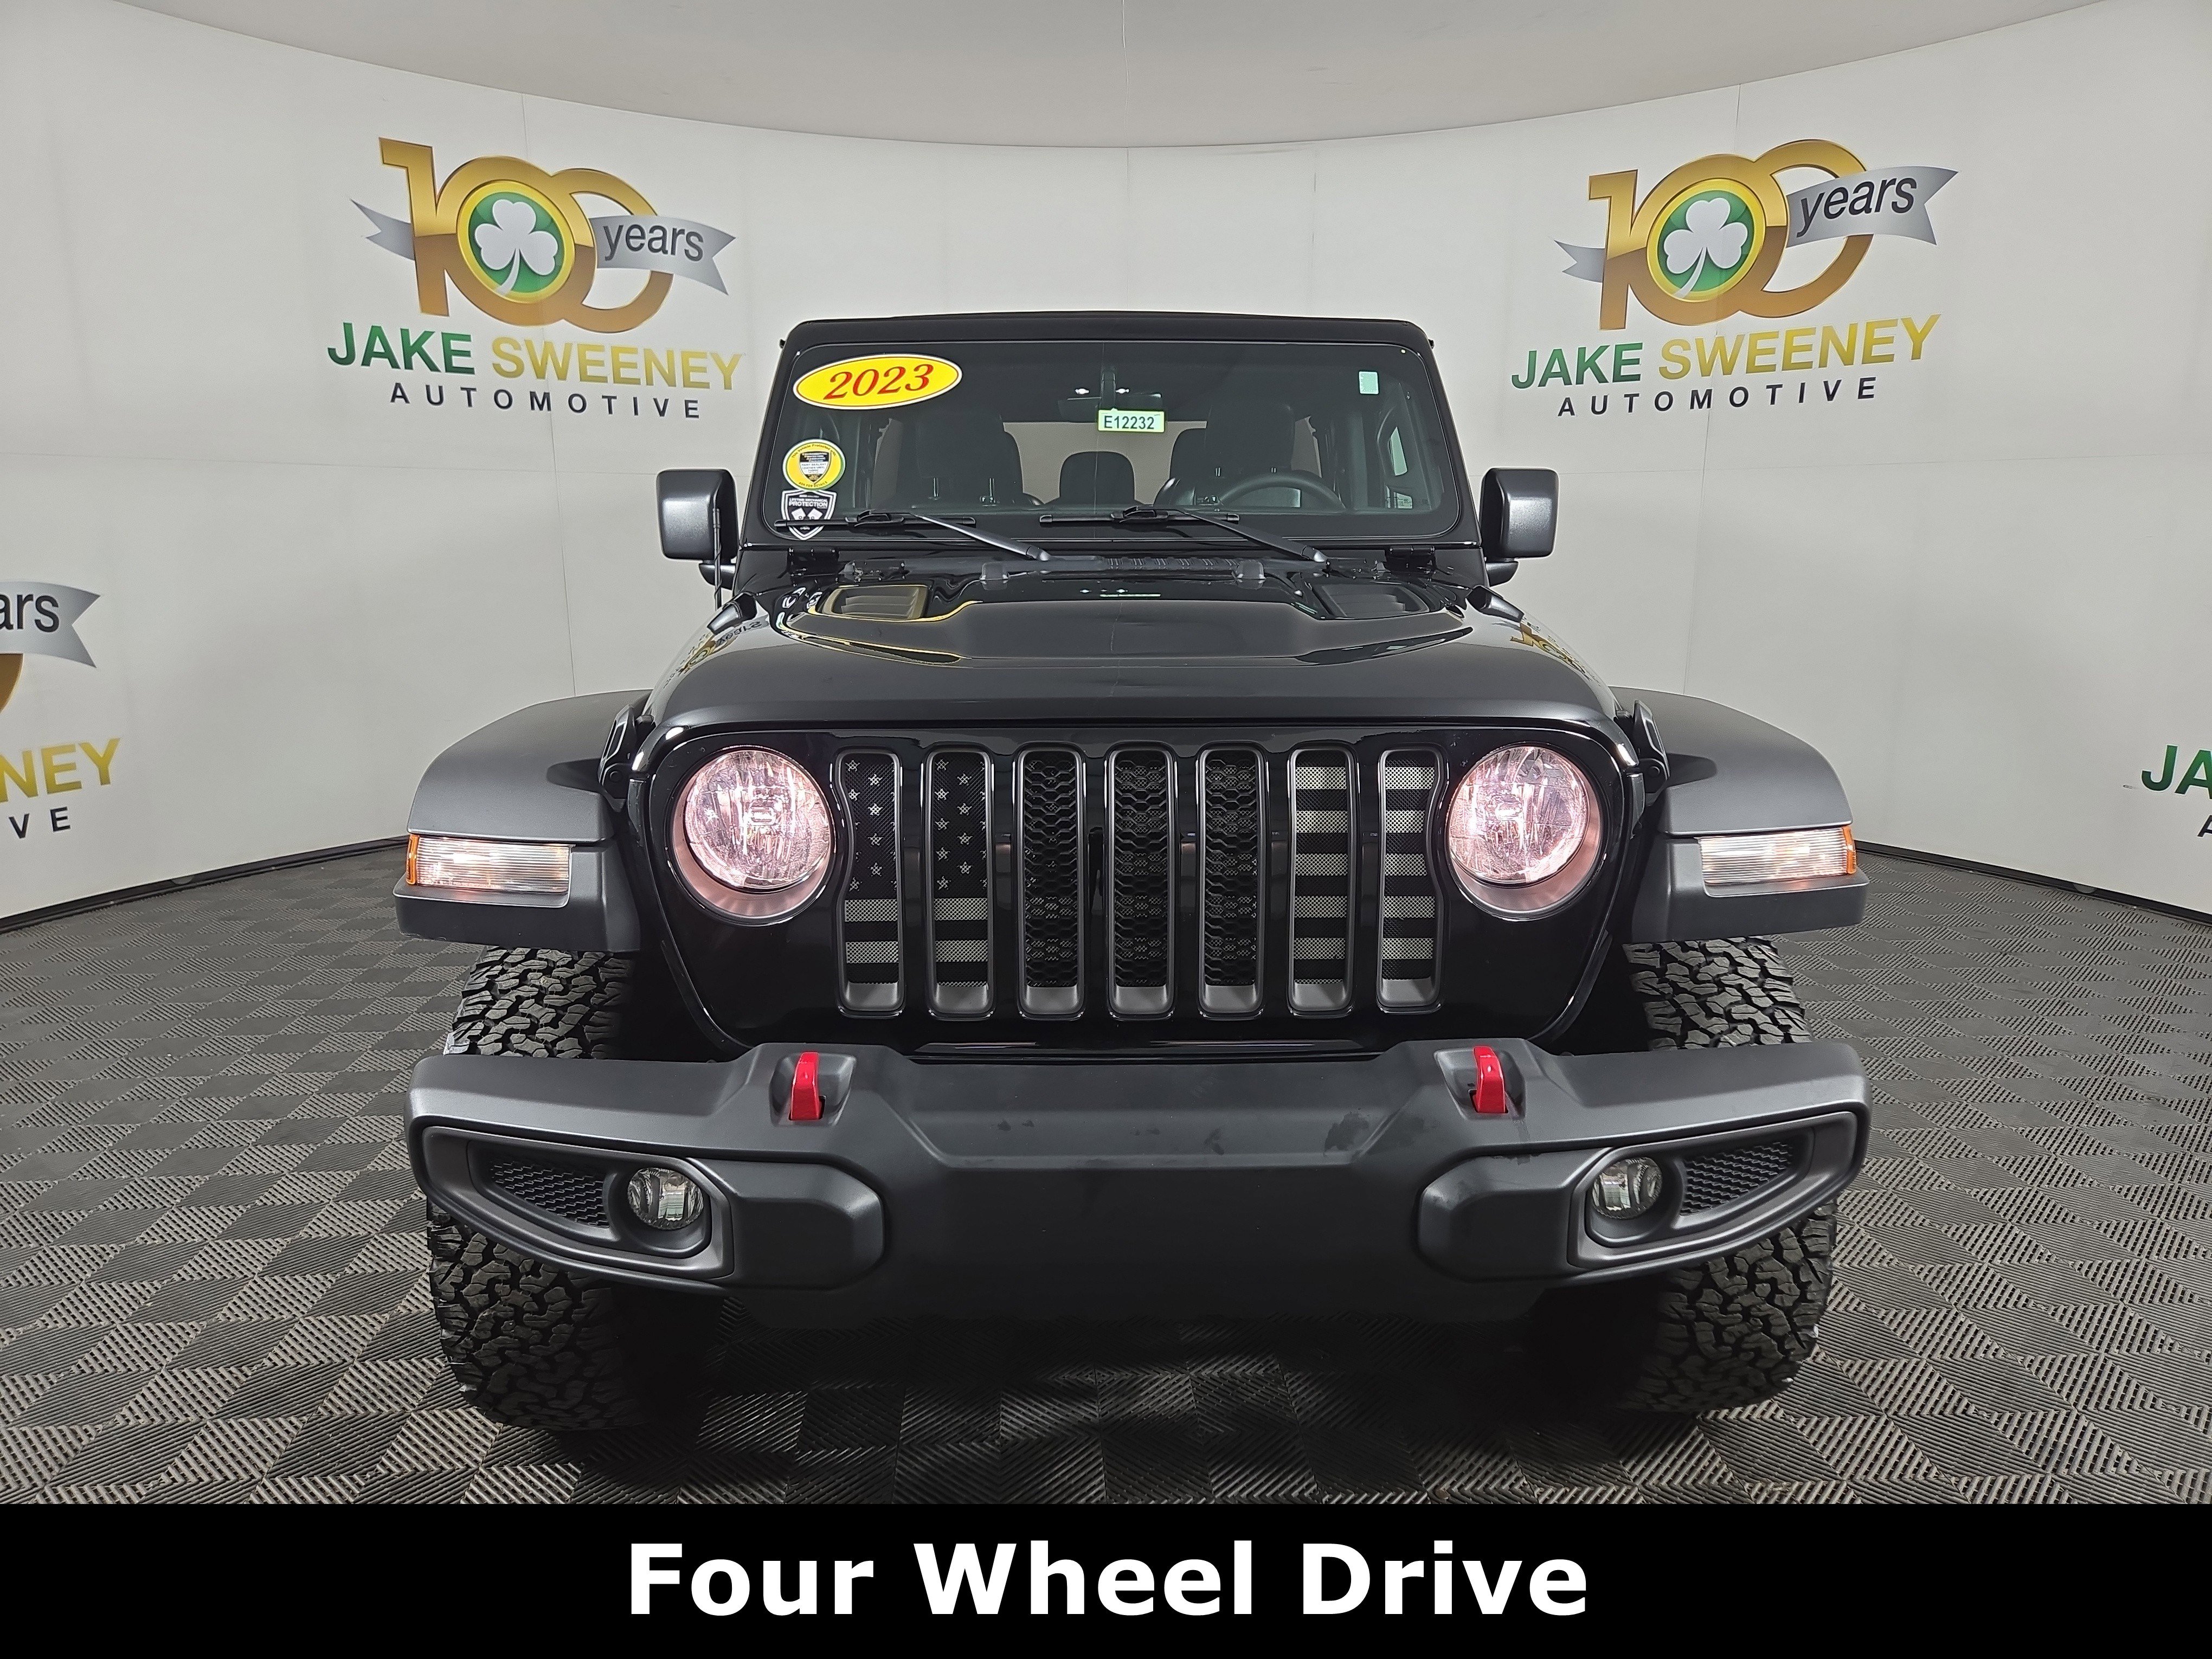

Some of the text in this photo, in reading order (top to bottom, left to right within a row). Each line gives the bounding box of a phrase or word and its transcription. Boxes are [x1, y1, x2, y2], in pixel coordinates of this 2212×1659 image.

[1797, 176, 1917, 237] years
[603, 223, 704, 262] years
[327, 322, 745, 390] JAKE SWEENEY
[1511, 314, 1941, 390] JAKE SWEENEY
[390, 382, 700, 419] AUTOMOTIVE
[823, 364, 934, 400] 2023
[1557, 376, 1877, 417] AUTOMOTIVE
[1104, 415, 1155, 429] E12232
